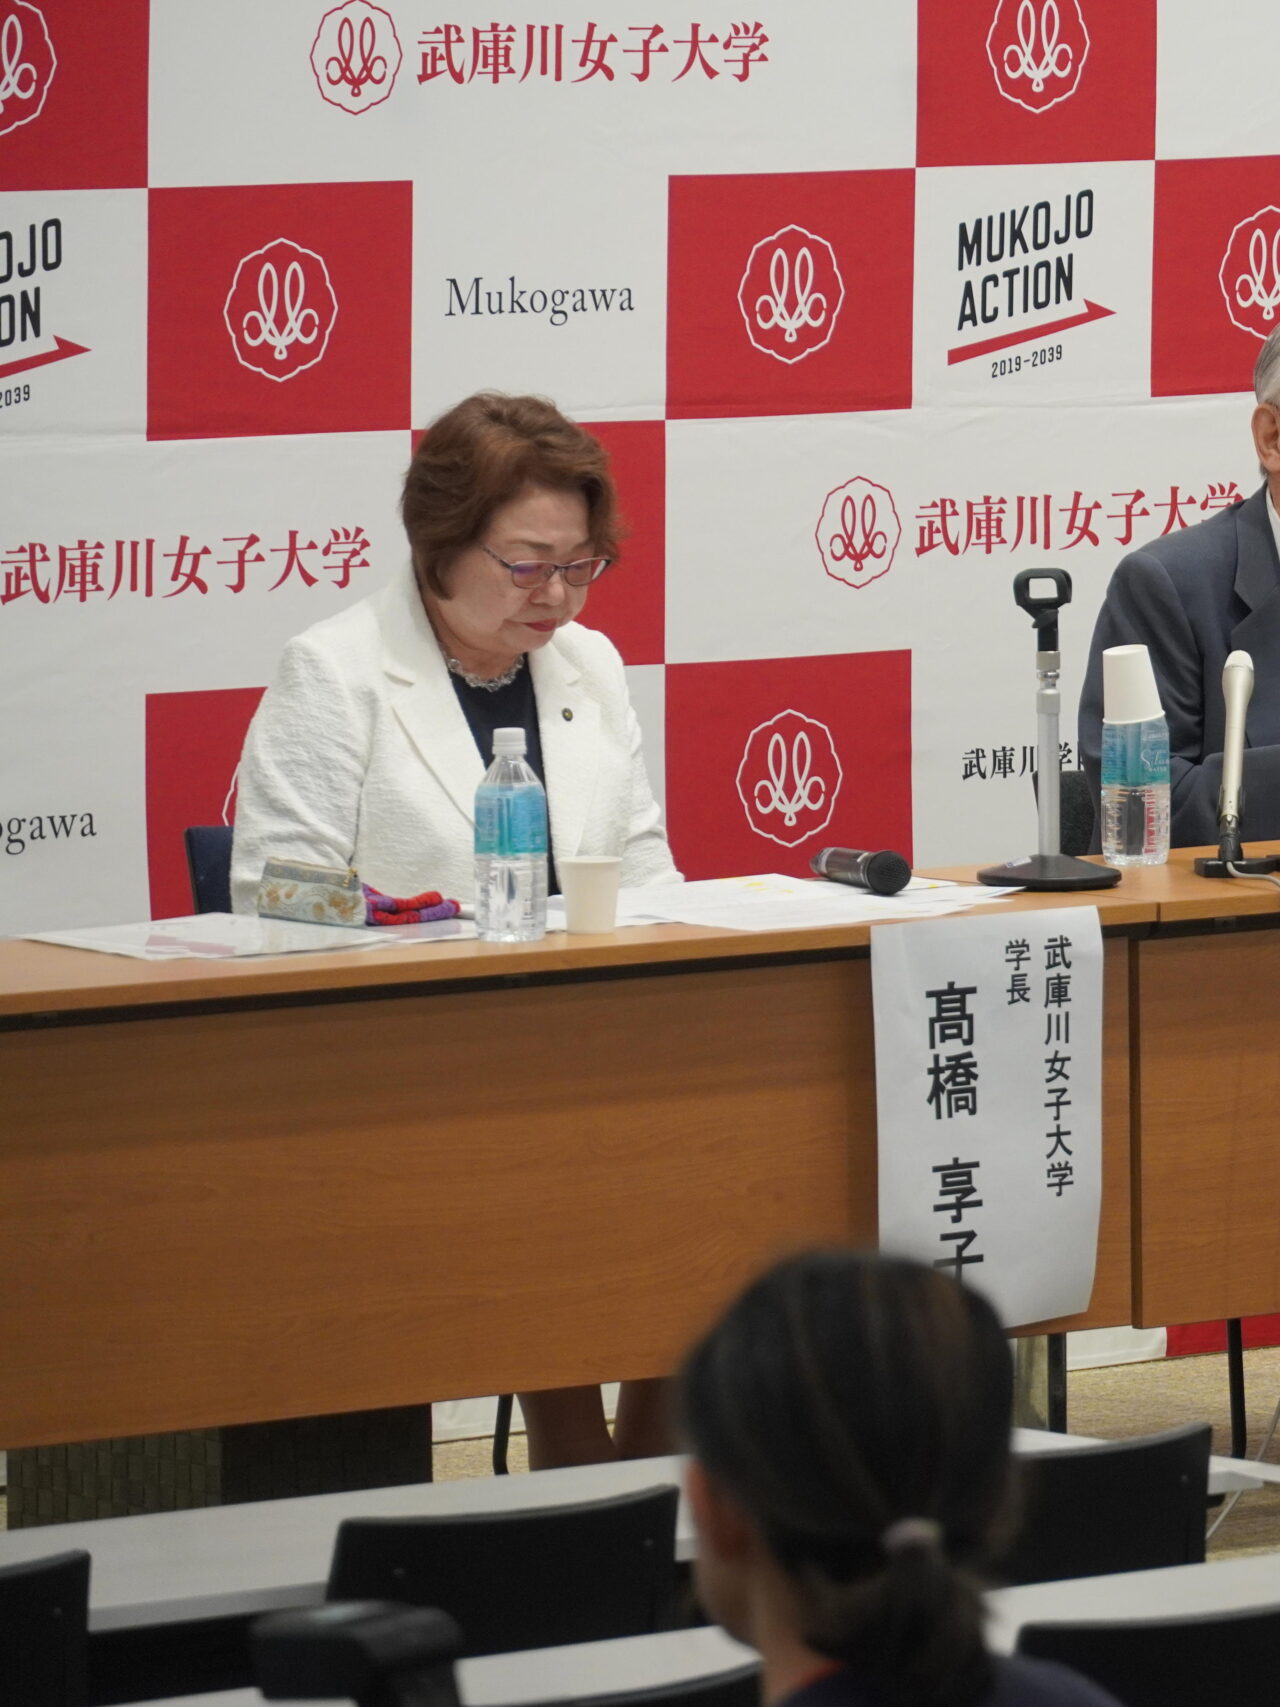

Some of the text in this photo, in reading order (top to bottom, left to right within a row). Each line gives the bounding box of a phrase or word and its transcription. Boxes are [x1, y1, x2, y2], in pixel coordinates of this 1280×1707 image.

[416, 21, 770, 85] 武庫川女子大学
[957, 189, 1094, 271] MUKOJO
[444, 277, 635, 326] Mukogawa
[957, 252, 1075, 331] ACTION
[990, 343, 1063, 378] 2019-2039
[0, 526, 371, 606] 武庫川女子大学
[1005, 938, 1032, 1006] 学長
[1043, 934, 1075, 1197] 武庫川女子大学
[932, 1157, 984, 1280] 享子
